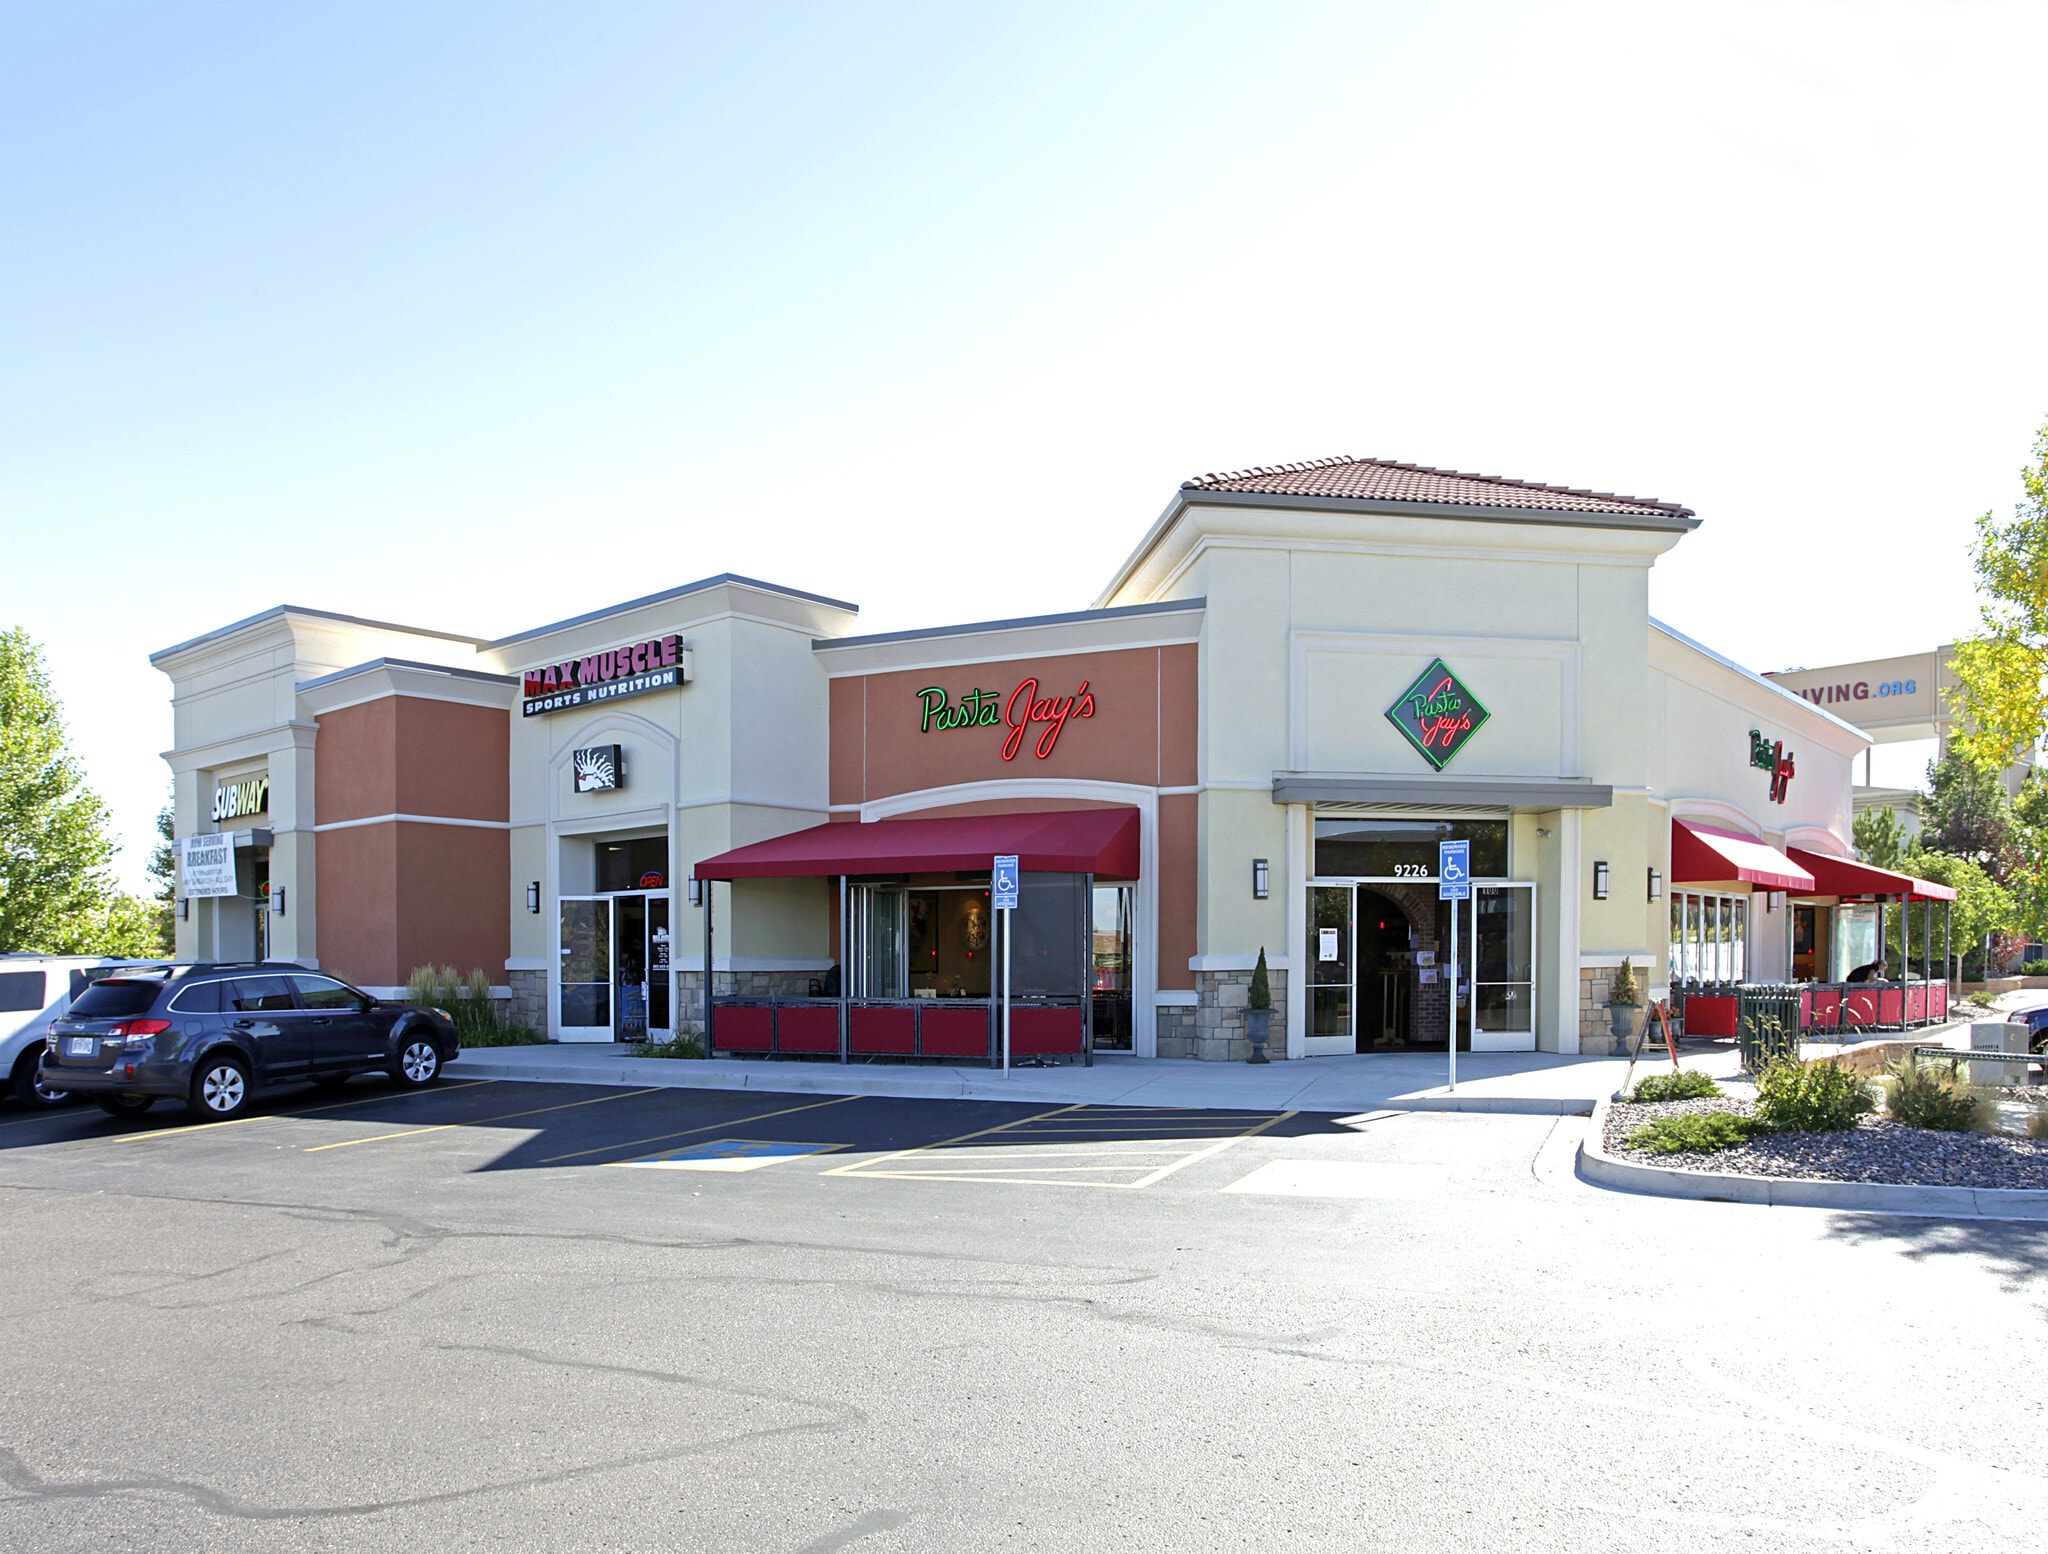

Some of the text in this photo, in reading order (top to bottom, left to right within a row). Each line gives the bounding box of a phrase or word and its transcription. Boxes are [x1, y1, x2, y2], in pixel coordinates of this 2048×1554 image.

[524, 634, 683, 698] MAX MUSCLE
[525, 671, 674, 714] SPORTS NUTRITION
[1408, 691, 1461, 719] Pasta
[1791, 679, 1917, 705] IVING.ORG
[917, 677, 1096, 761] Pasta Jay's
[1419, 677, 1472, 747] Jay's
[211, 778, 269, 820] SUBWAY
[187, 848, 227, 867] BREAKFAST
[1394, 864, 1428, 877] 9226
[640, 875, 664, 888] OPEN
